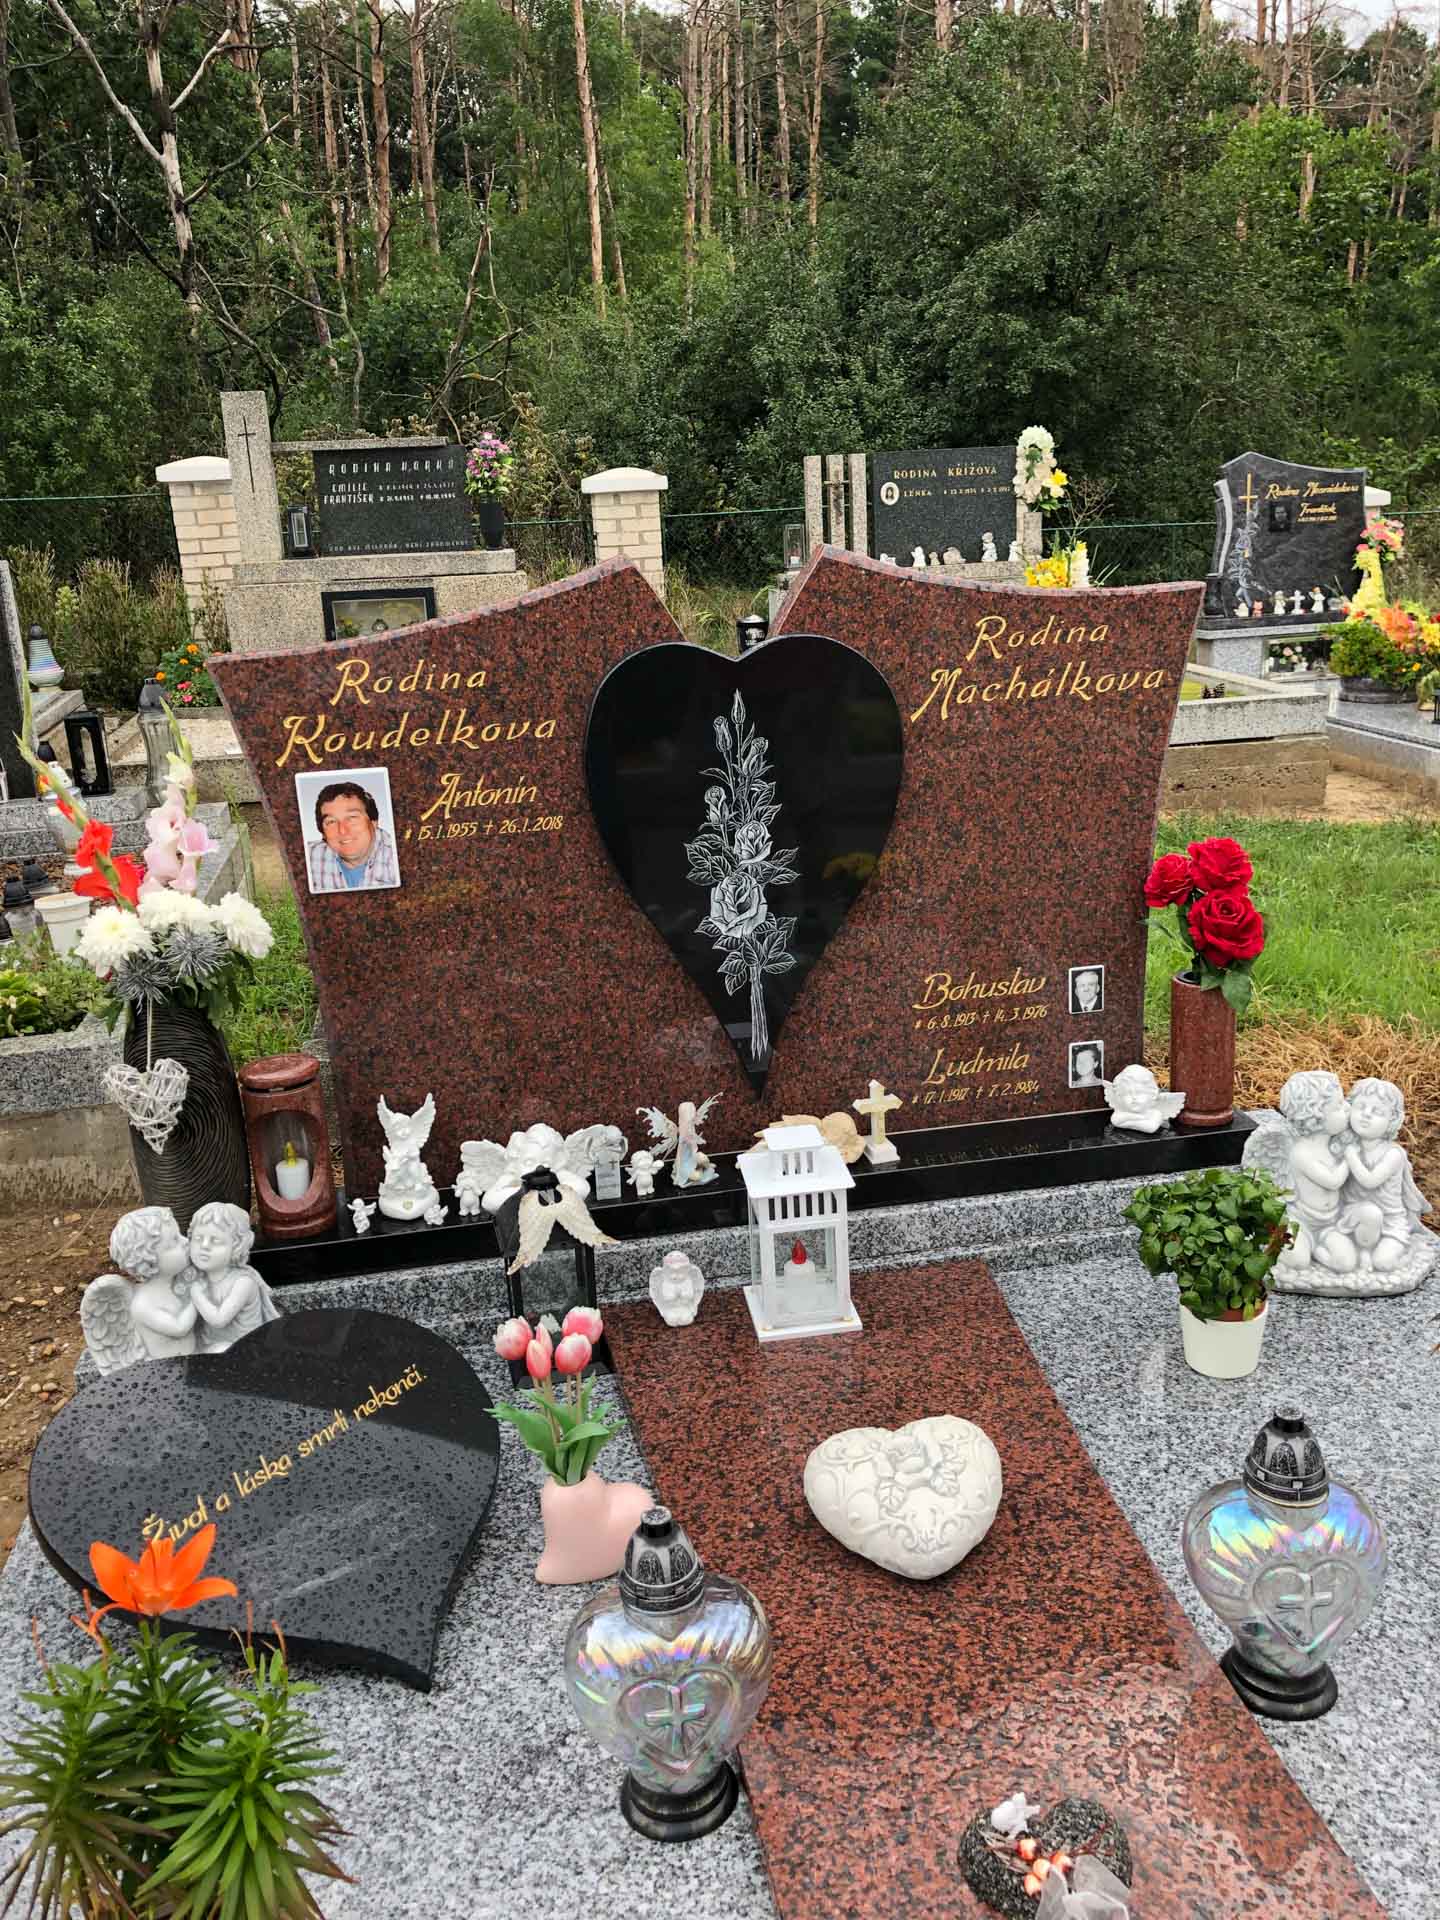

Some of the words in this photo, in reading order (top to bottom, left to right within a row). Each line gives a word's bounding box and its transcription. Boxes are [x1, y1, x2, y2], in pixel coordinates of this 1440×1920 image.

[894, 469, 937, 479] RODINA
[965, 615, 1109, 662] Rodina
[329, 658, 488, 707] Rodina
[910, 661, 1165, 723] Machálkova
[275, 707, 558, 768] Koudelkova
[420, 772, 538, 822] Antonín
[500, 815, 564, 835] 26.1.2018
[912, 966, 1047, 1010] Bohuslav
[920, 1041, 1031, 1085] Ludmila
[142, 1495, 209, 1541] Život
[215, 1492, 231, 1512] a
[233, 1455, 293, 1497] láska
[297, 1408, 349, 1458] smrti
